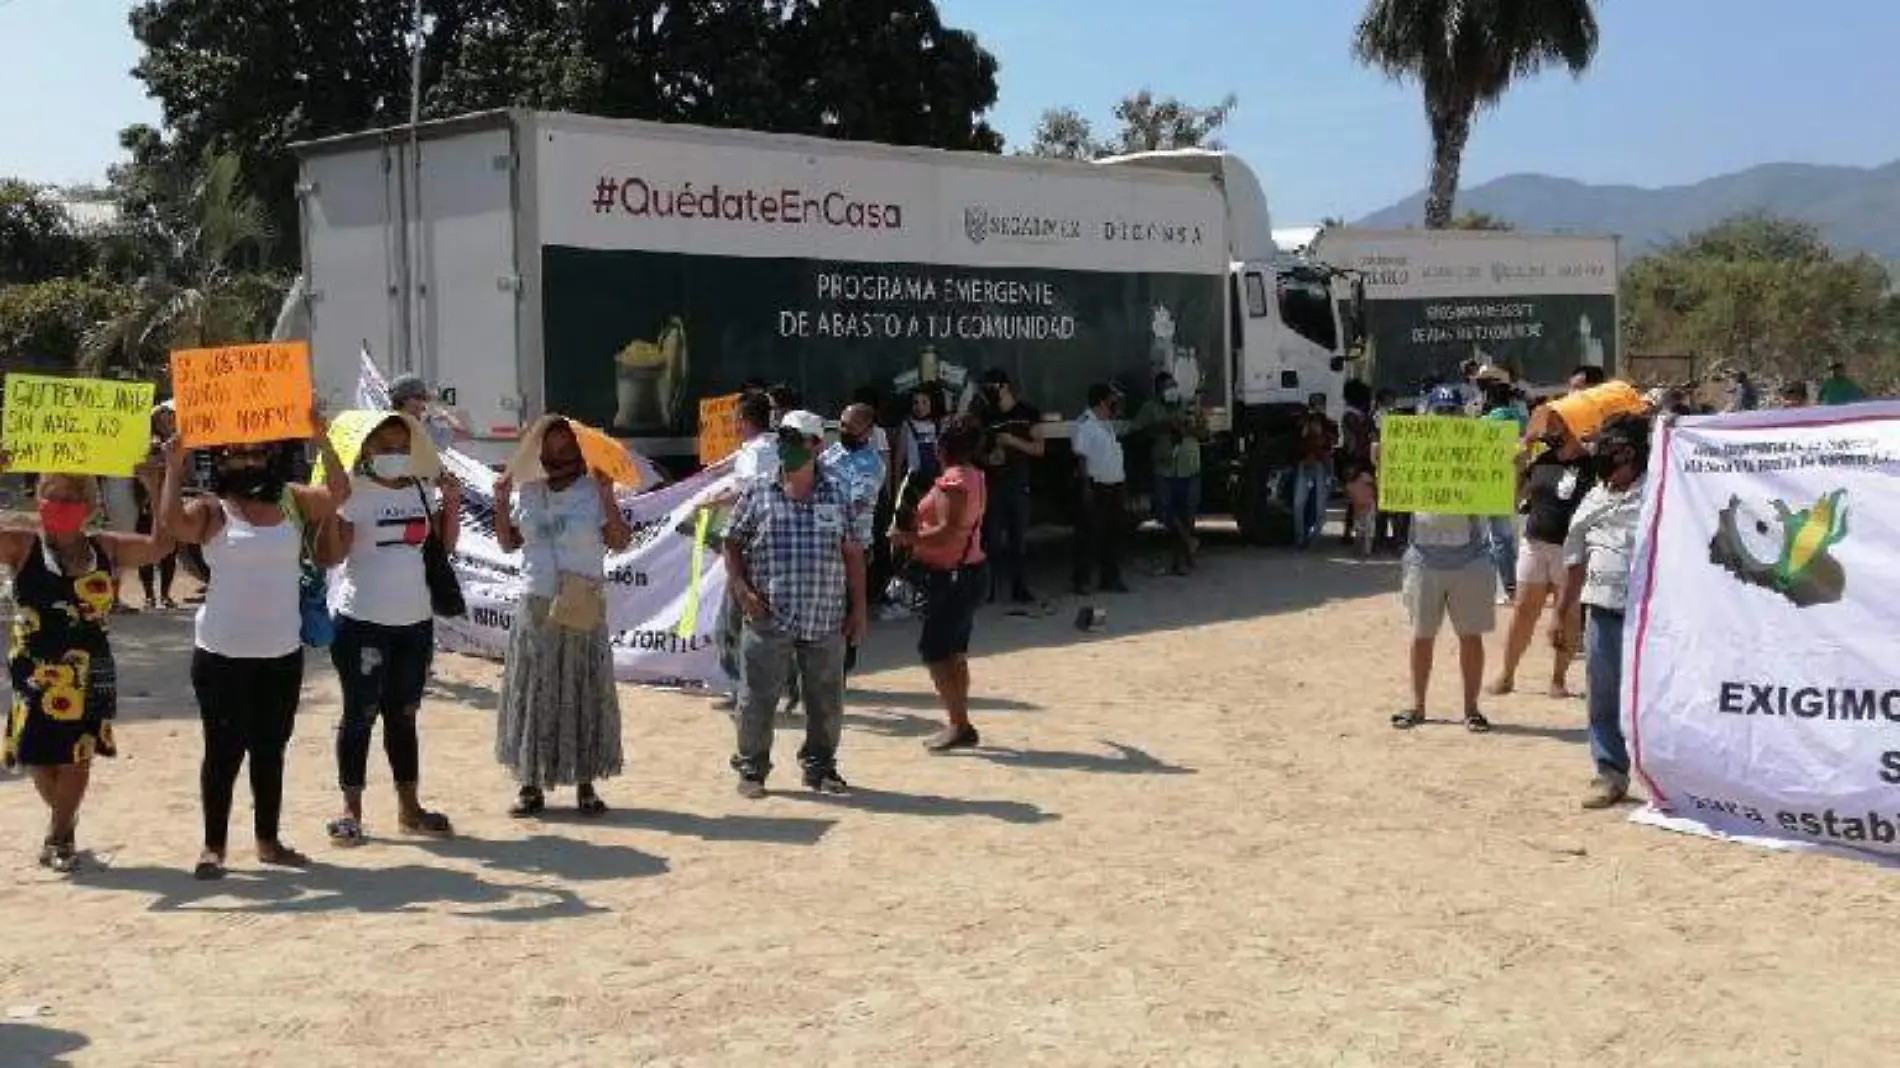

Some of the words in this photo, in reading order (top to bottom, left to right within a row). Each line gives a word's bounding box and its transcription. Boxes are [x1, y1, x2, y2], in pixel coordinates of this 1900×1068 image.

[817, 273, 937, 300] PROGRAMA
[943, 278, 1053, 304] EMERGENTE
[780, 310, 809, 337] DE
[817, 312, 901, 338] ABASTO
[907, 315, 920, 337] A
[928, 315, 952, 338] TU
[957, 314, 1076, 340] COMUNIDAD
[472, 607, 511, 631] INDU
